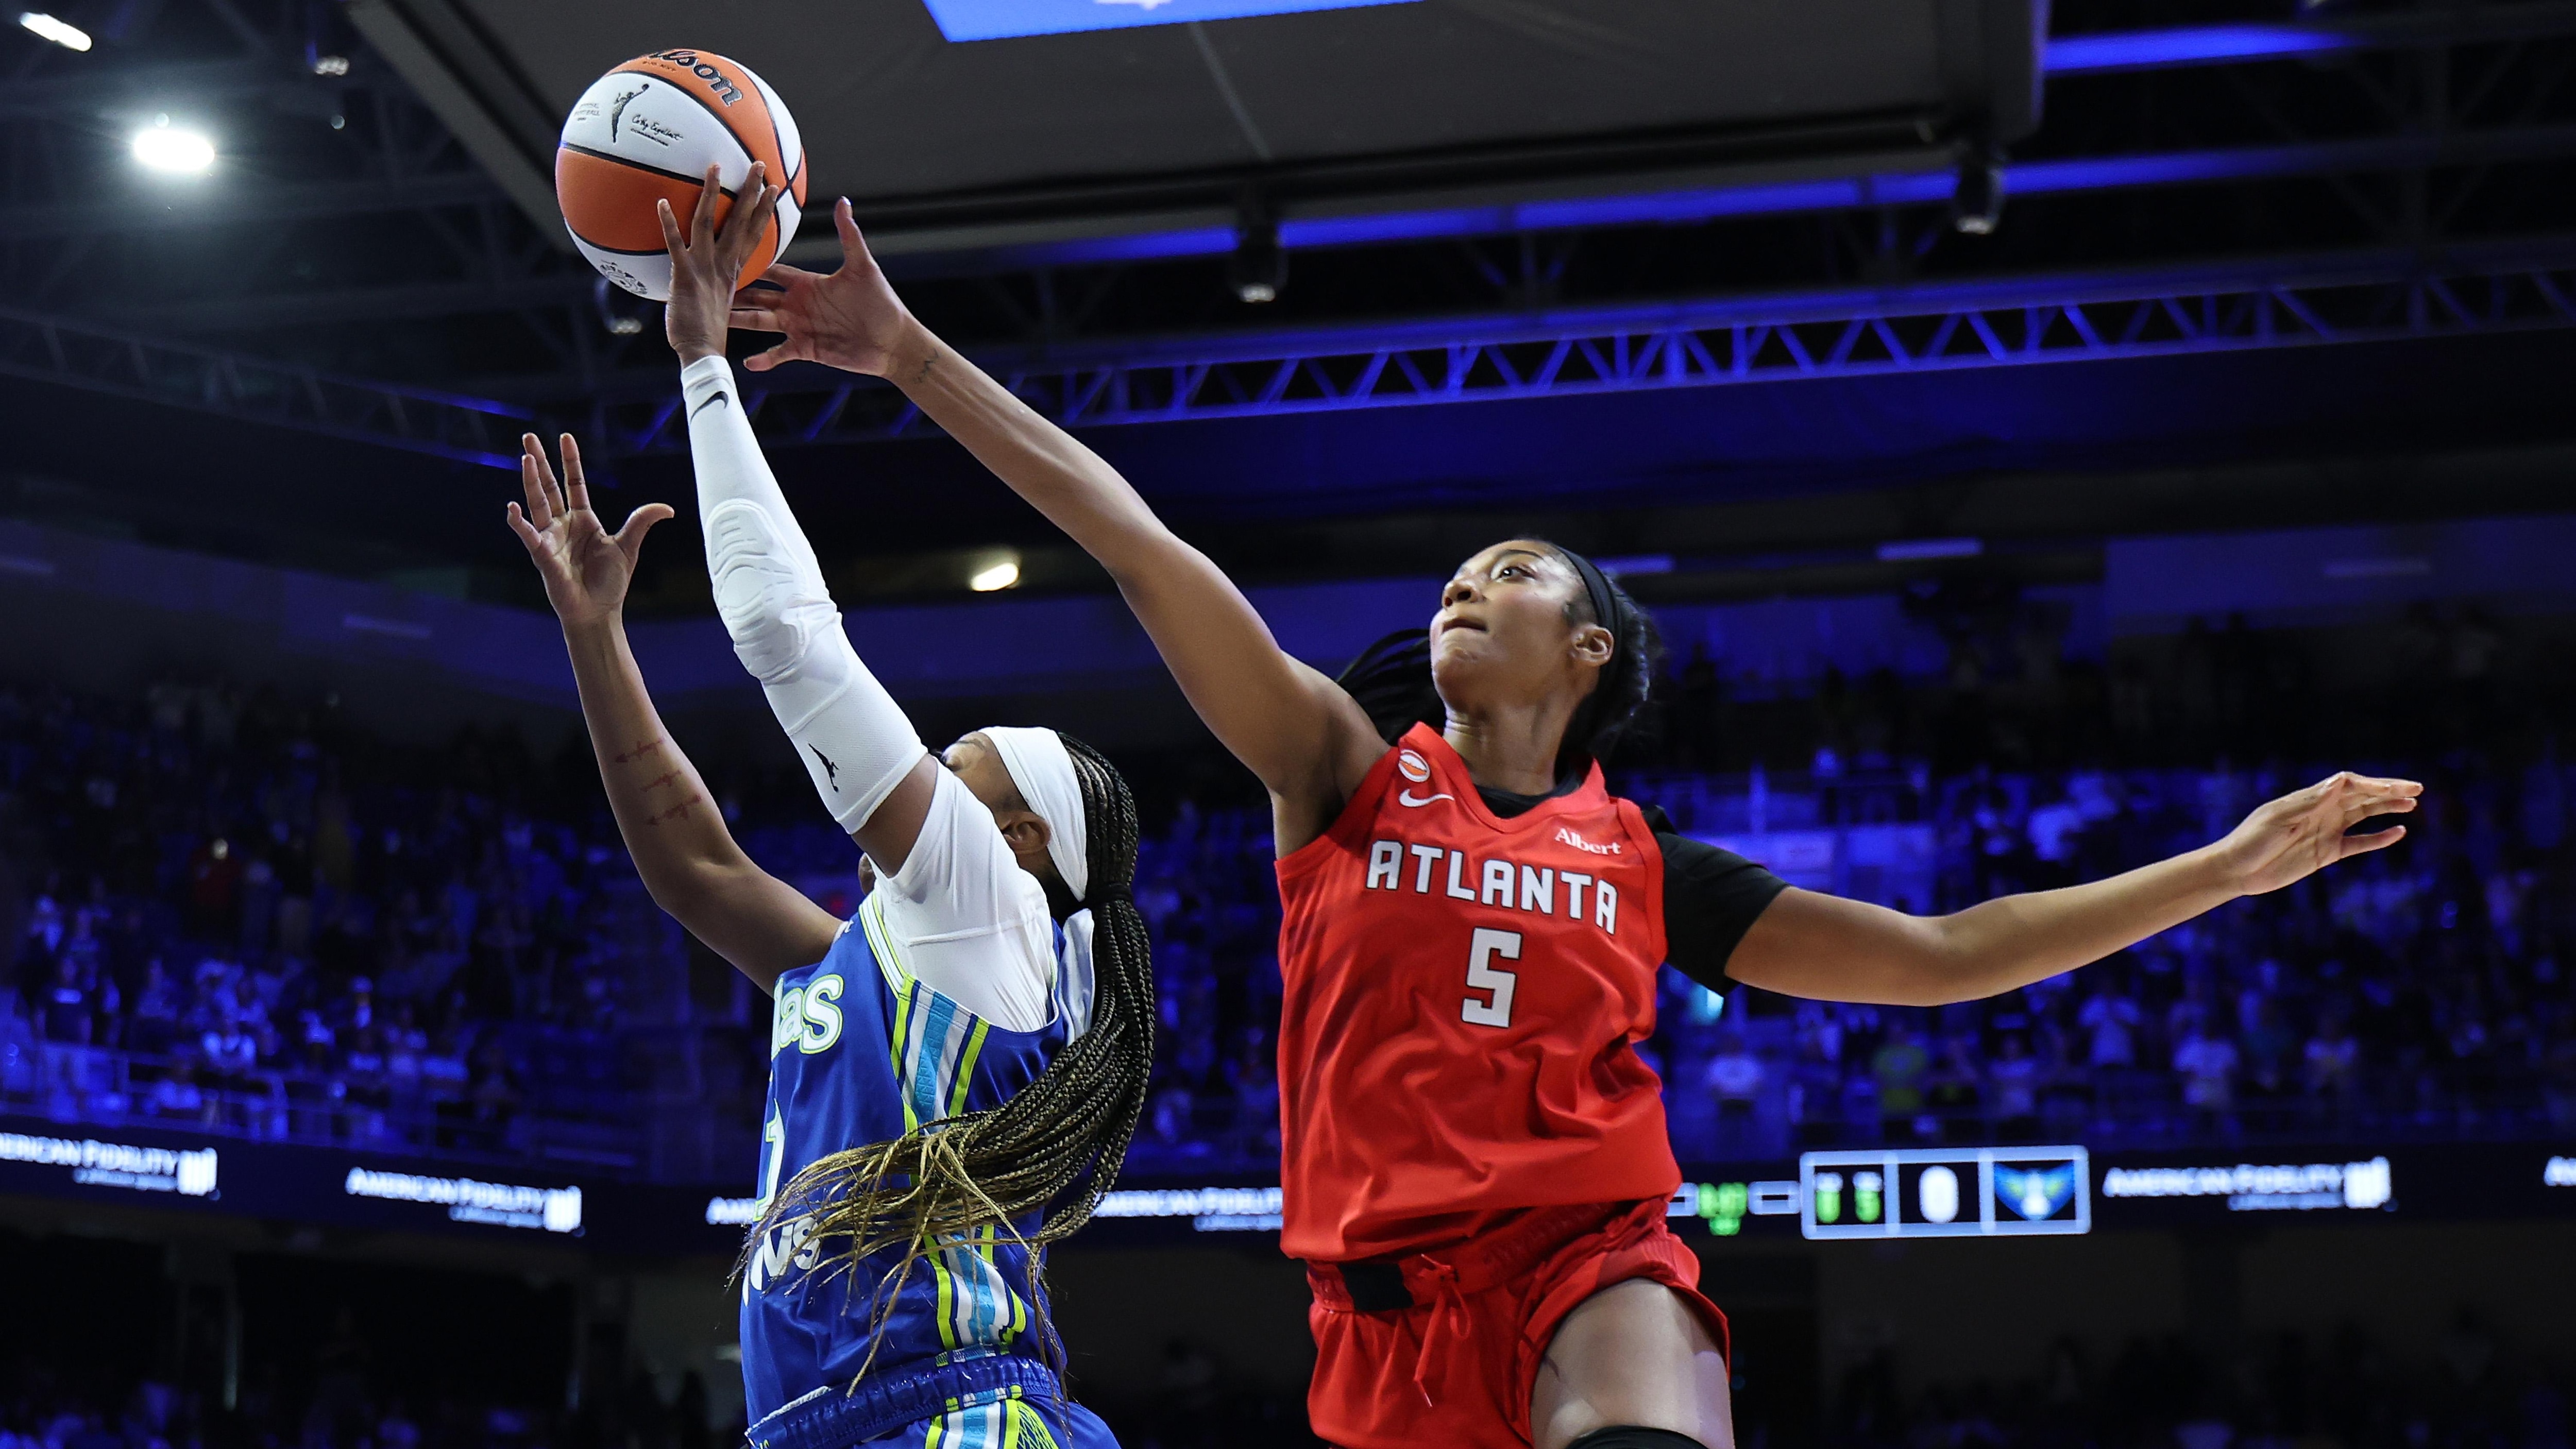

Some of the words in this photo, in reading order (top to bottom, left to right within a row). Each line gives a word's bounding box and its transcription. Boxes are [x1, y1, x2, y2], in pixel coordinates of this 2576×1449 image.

[1366, 840, 1618, 934] ATLANTA
[1554, 827, 1622, 856] Albert
[1461, 927, 1523, 1029] 5
